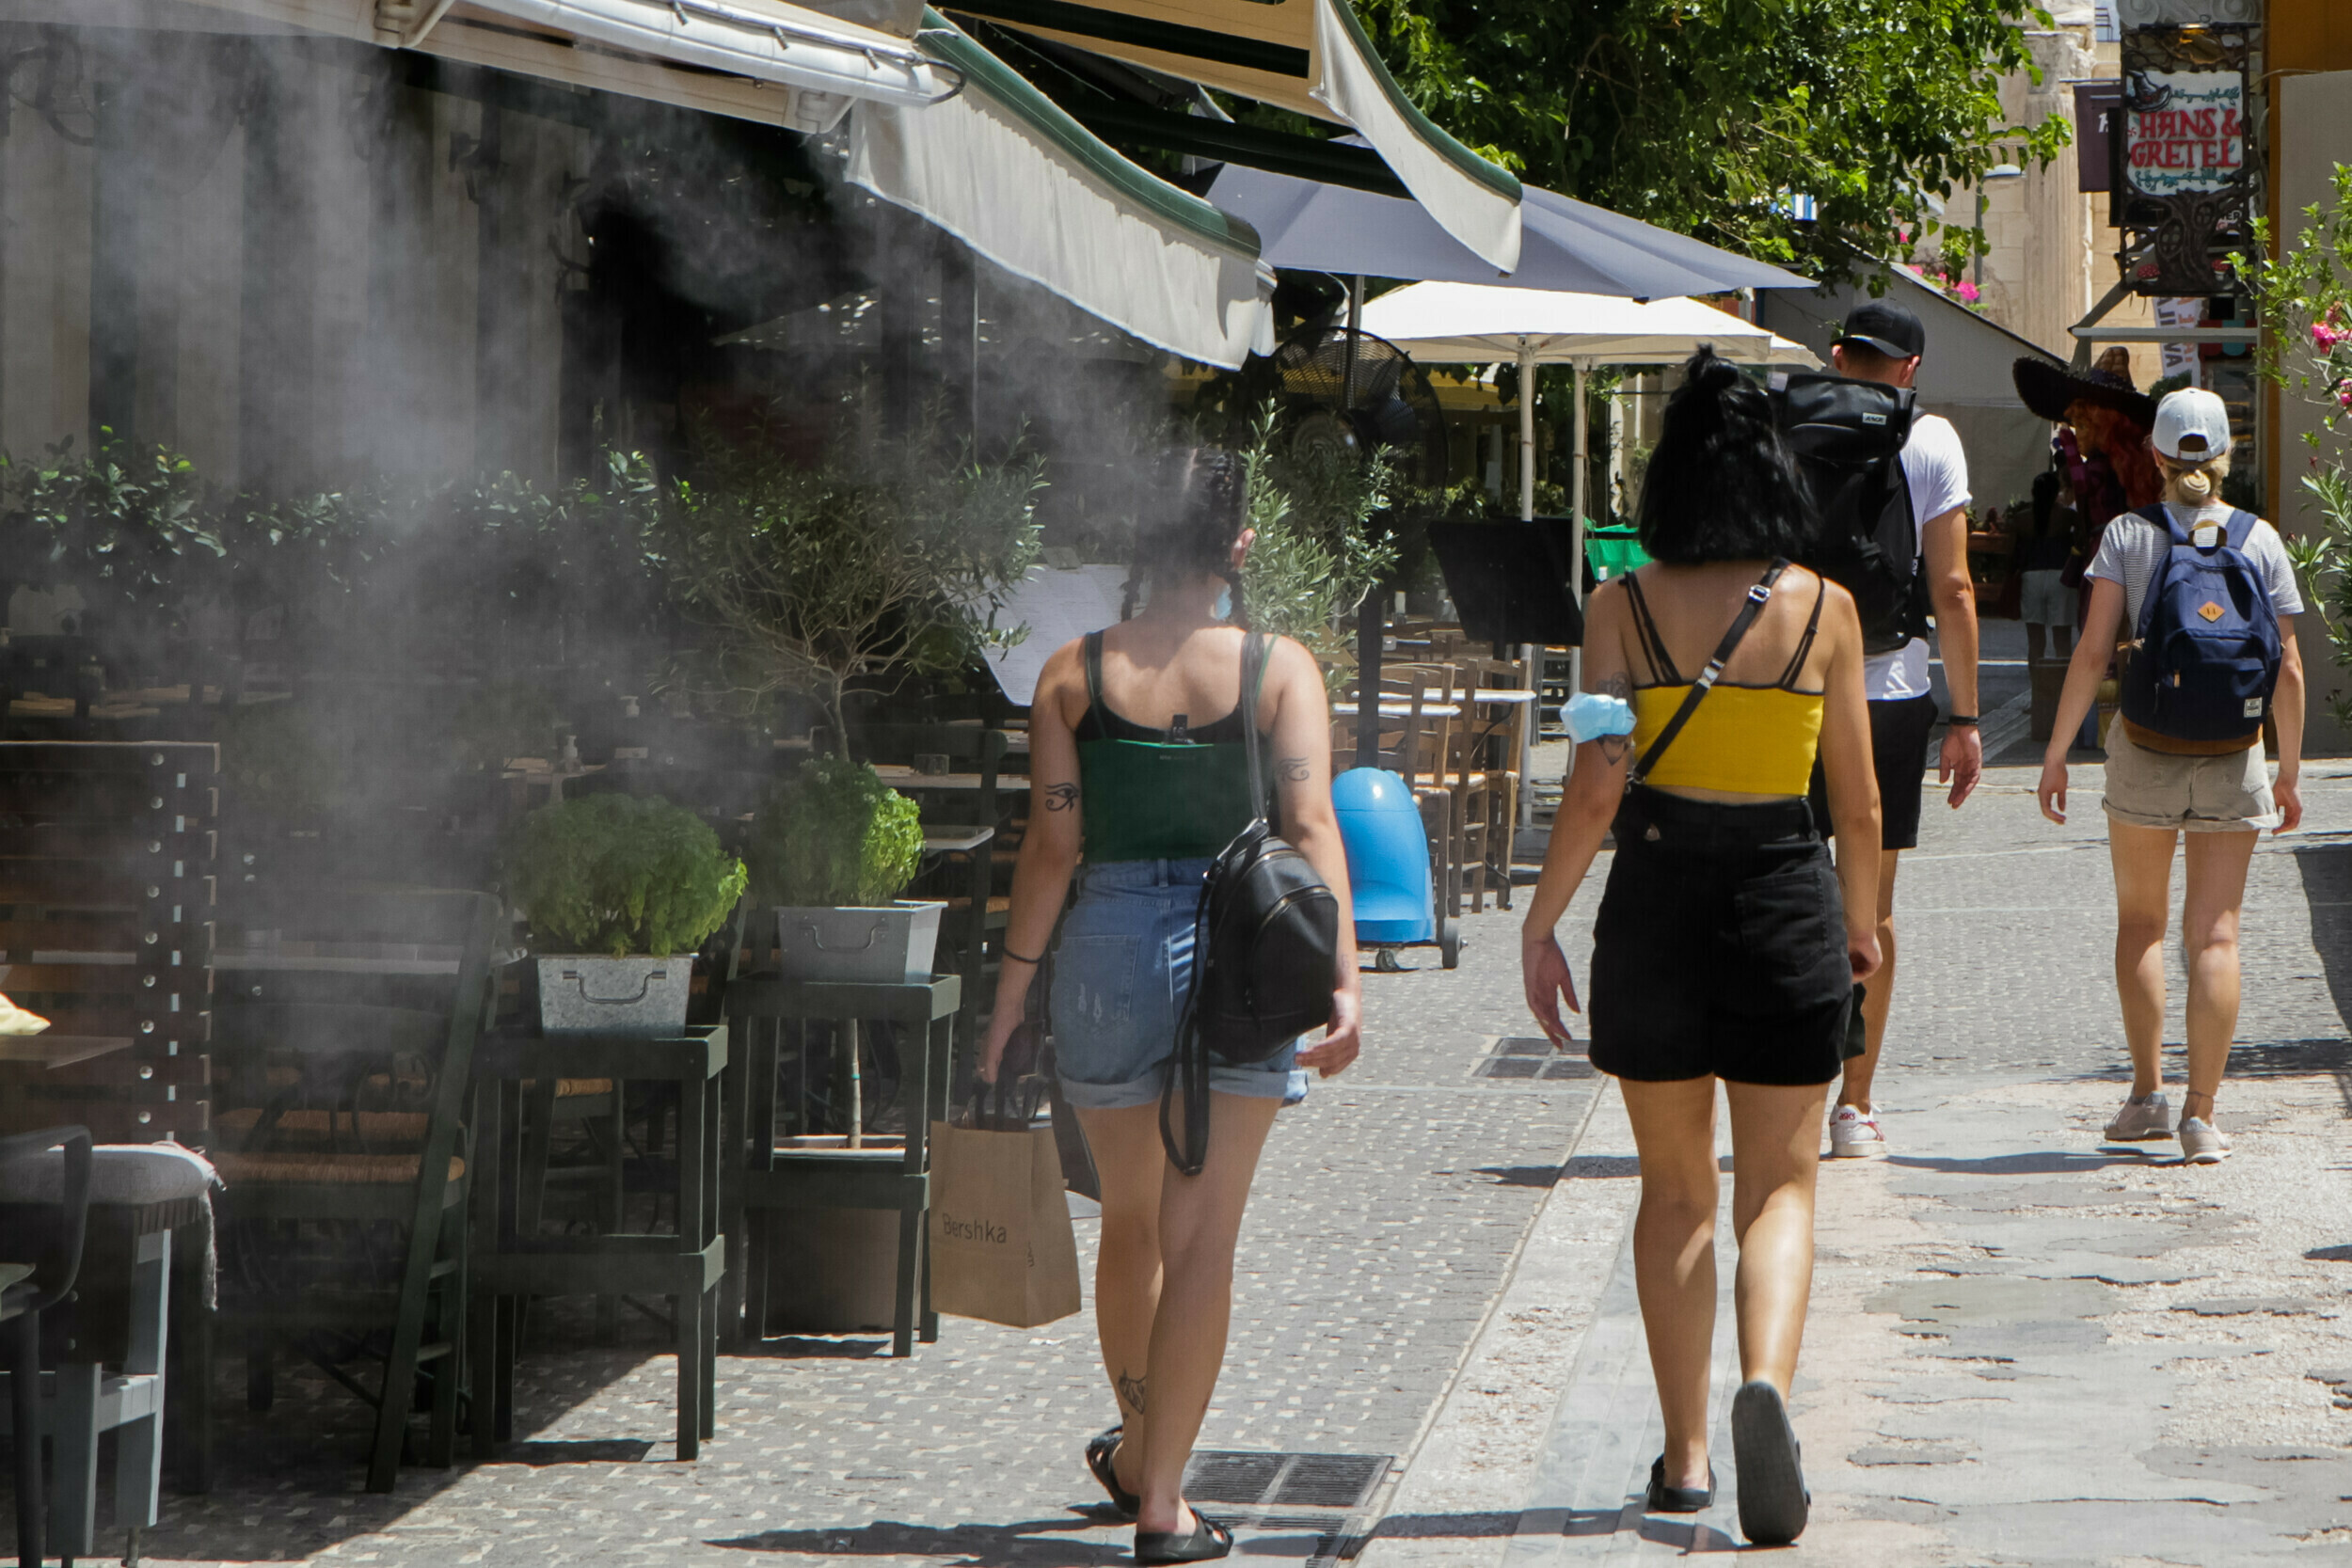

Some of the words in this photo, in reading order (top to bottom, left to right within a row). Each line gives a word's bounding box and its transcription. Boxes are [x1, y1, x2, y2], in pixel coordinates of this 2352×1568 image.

[2139, 108, 2217, 138] HANS
[2221, 108, 2242, 136] &
[2130, 139, 2241, 167] GRETEL
[943, 1212, 1007, 1243] Bershka
